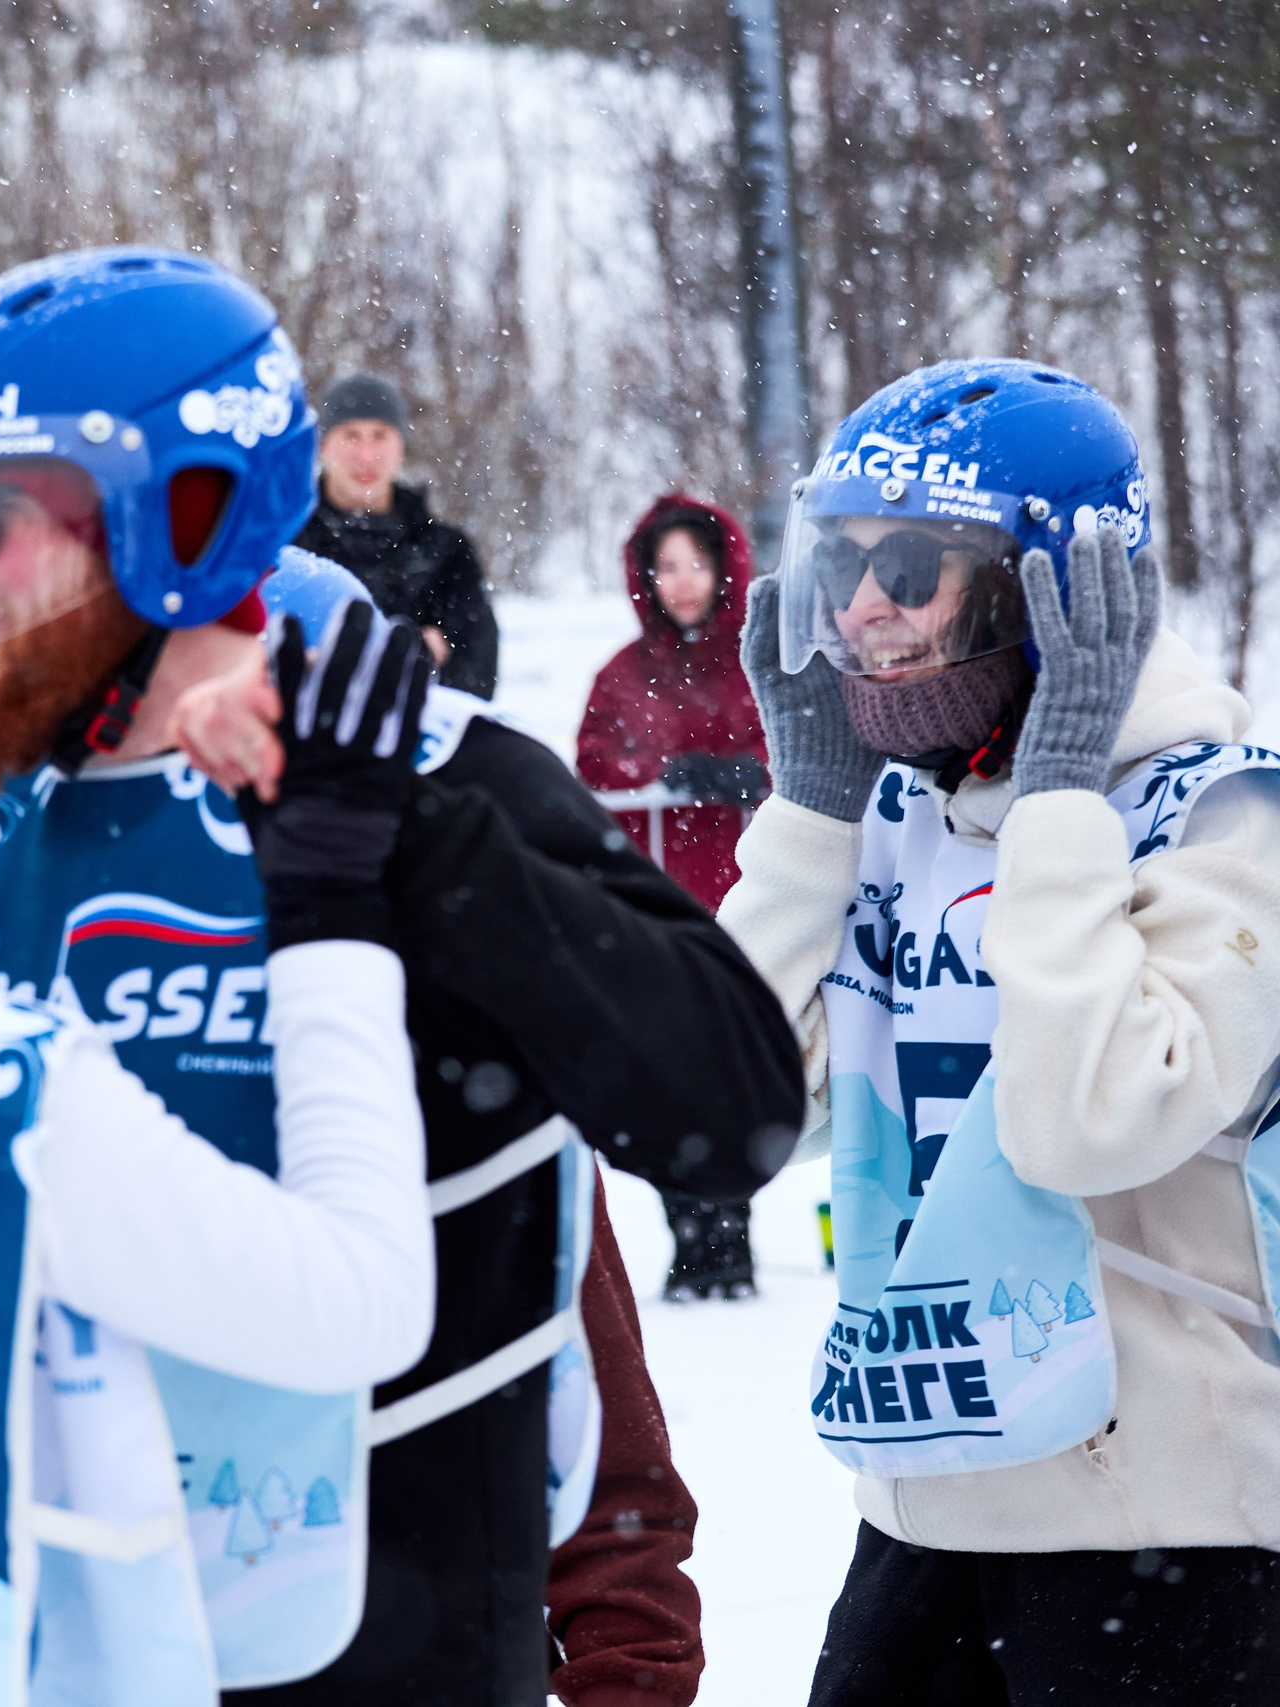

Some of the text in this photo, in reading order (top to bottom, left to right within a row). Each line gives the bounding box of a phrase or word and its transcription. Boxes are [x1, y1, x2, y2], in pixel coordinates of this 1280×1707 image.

[812, 450, 980, 489] ИГАССЕН
[926, 499, 1003, 523] В РОССИИ
[928, 485, 993, 506] ПЕРВЫЕ
[820, 971, 865, 995] SSIA,
[10, 963, 276, 1044] ASSE
[831, 1321, 859, 1348] ЛЯ
[865, 1300, 980, 1354] ОЛК
[824, 1359, 997, 1424] НЕГЕ
